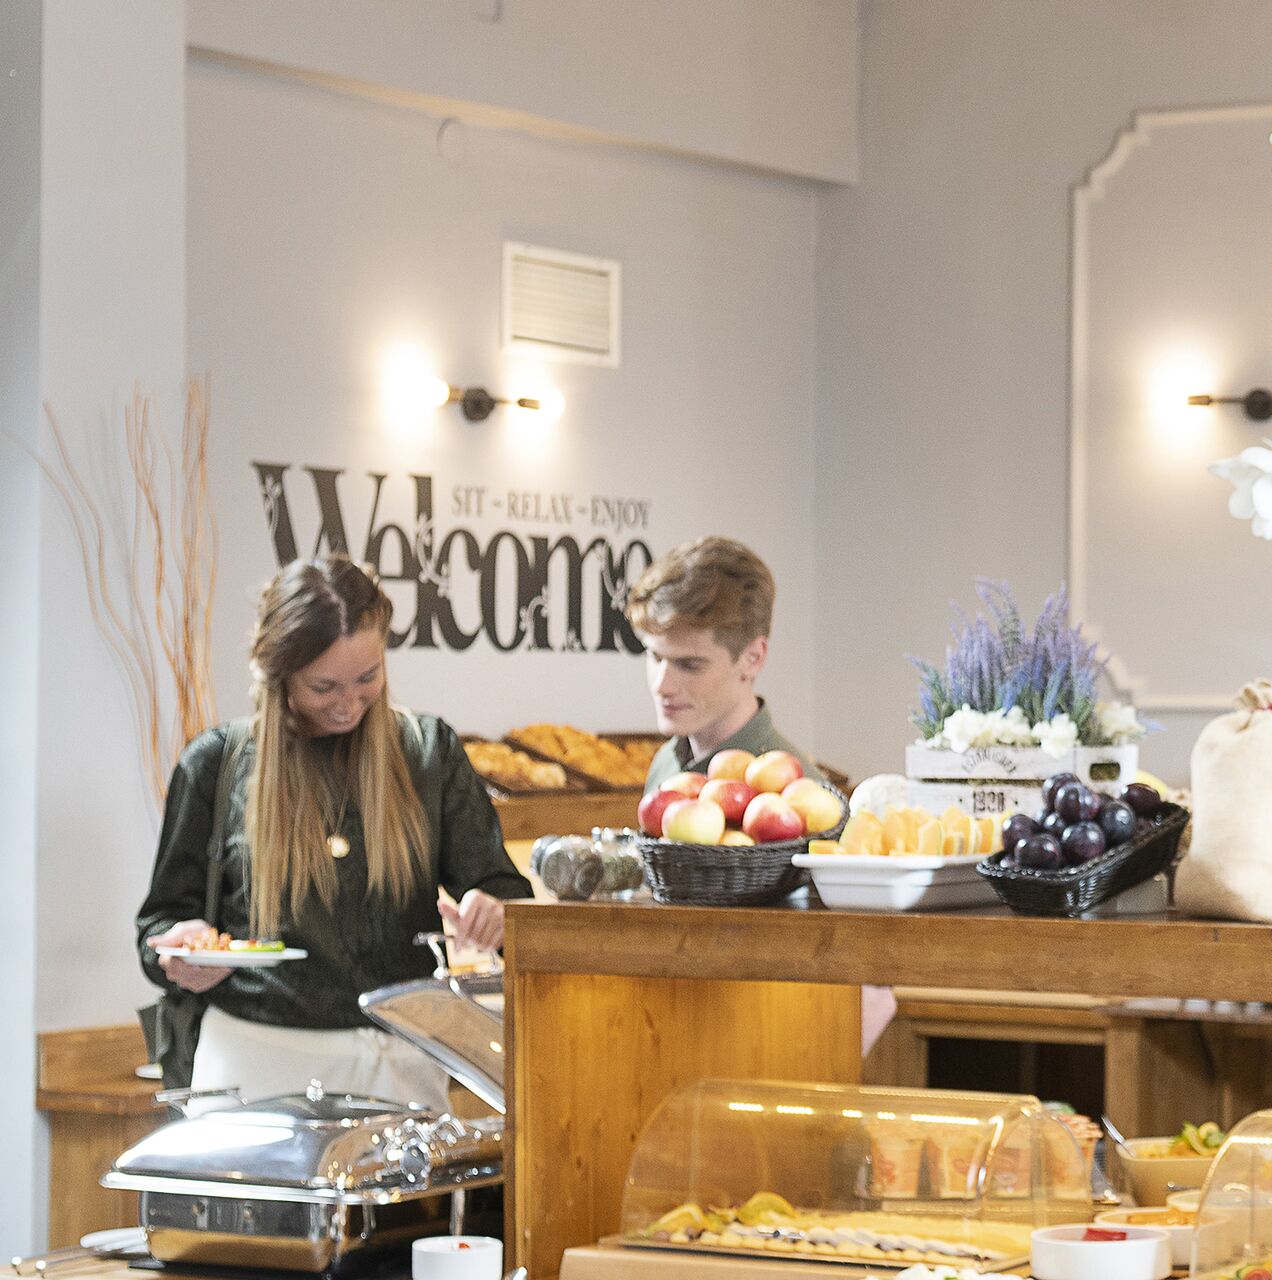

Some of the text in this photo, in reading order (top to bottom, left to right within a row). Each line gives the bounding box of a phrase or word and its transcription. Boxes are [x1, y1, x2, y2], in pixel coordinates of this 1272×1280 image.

[452, 485, 651, 534] SIT RELAX ENJOY
